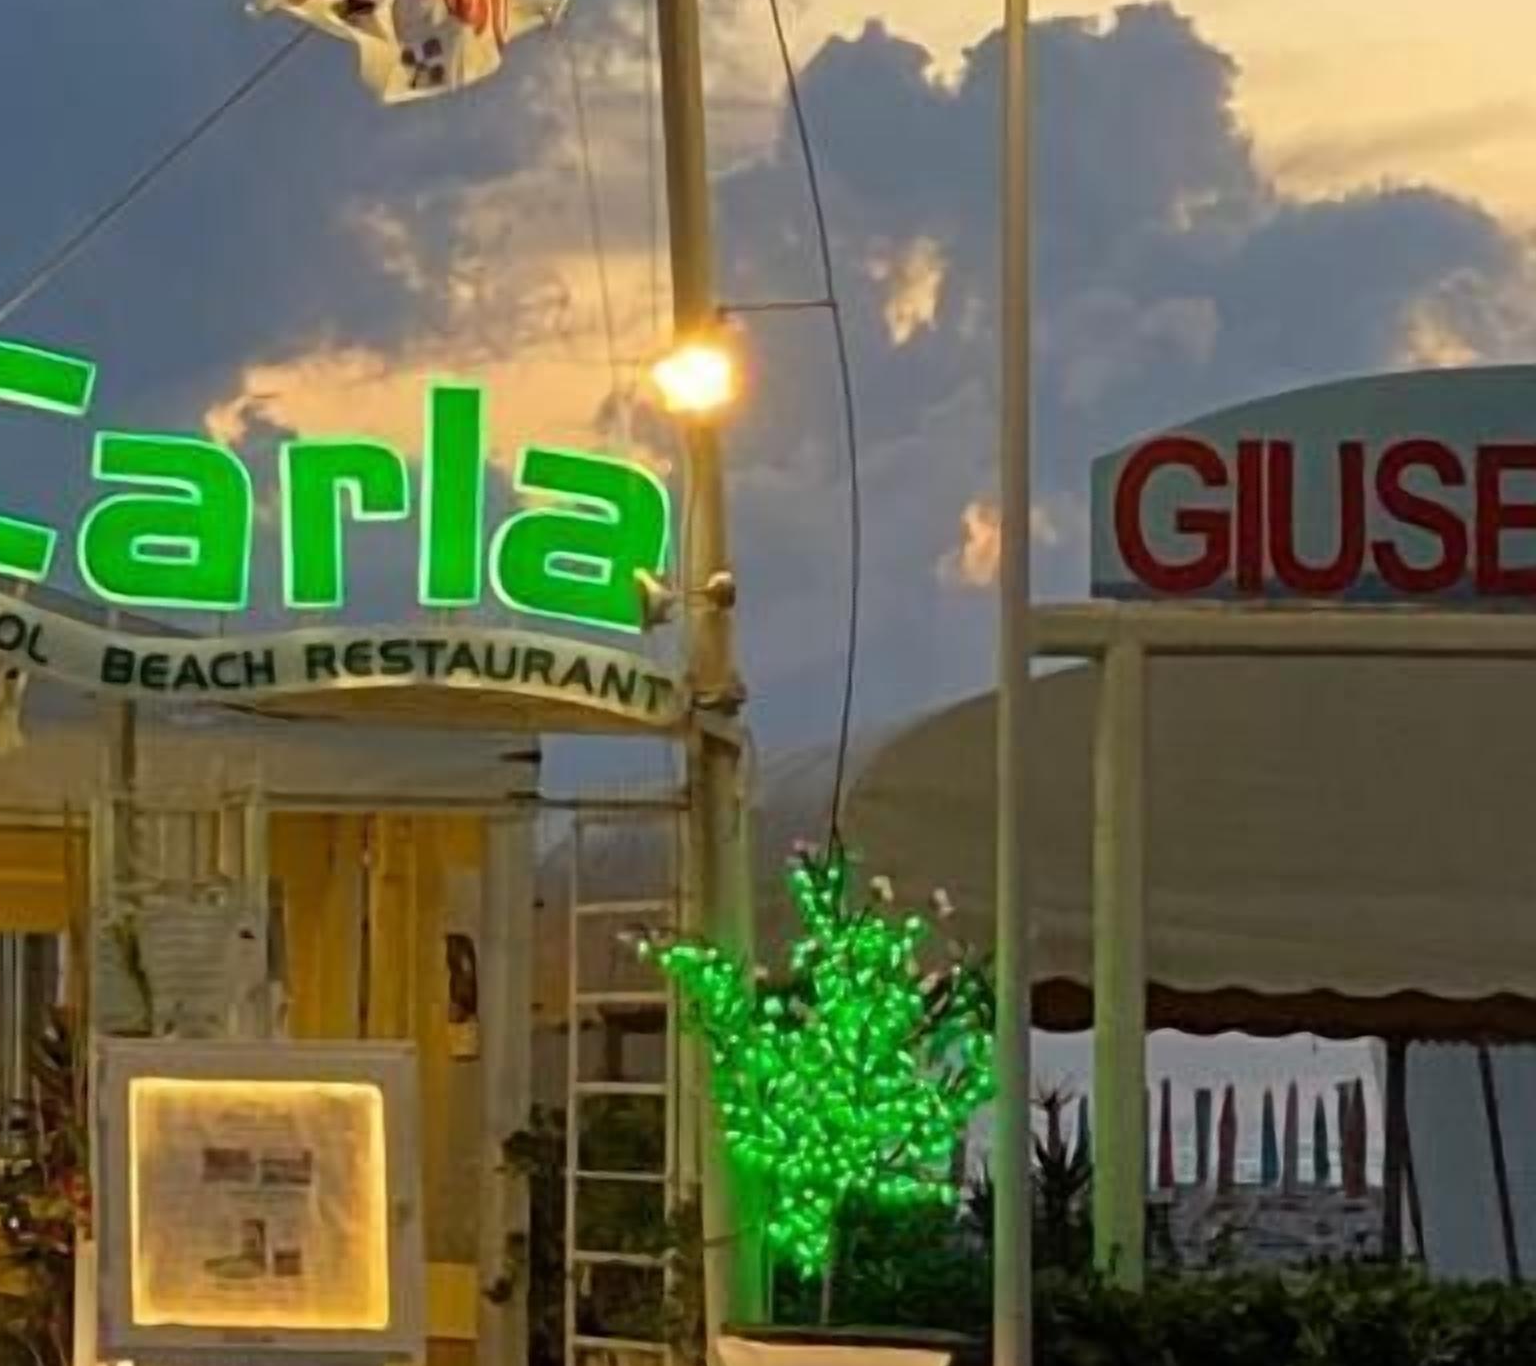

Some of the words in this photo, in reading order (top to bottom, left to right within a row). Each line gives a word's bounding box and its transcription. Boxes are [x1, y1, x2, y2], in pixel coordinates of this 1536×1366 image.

[1114, 436, 1536, 595] GIUSE
[99, 646, 276, 690] BEACH
[304, 638, 674, 713] RESTAURANT
